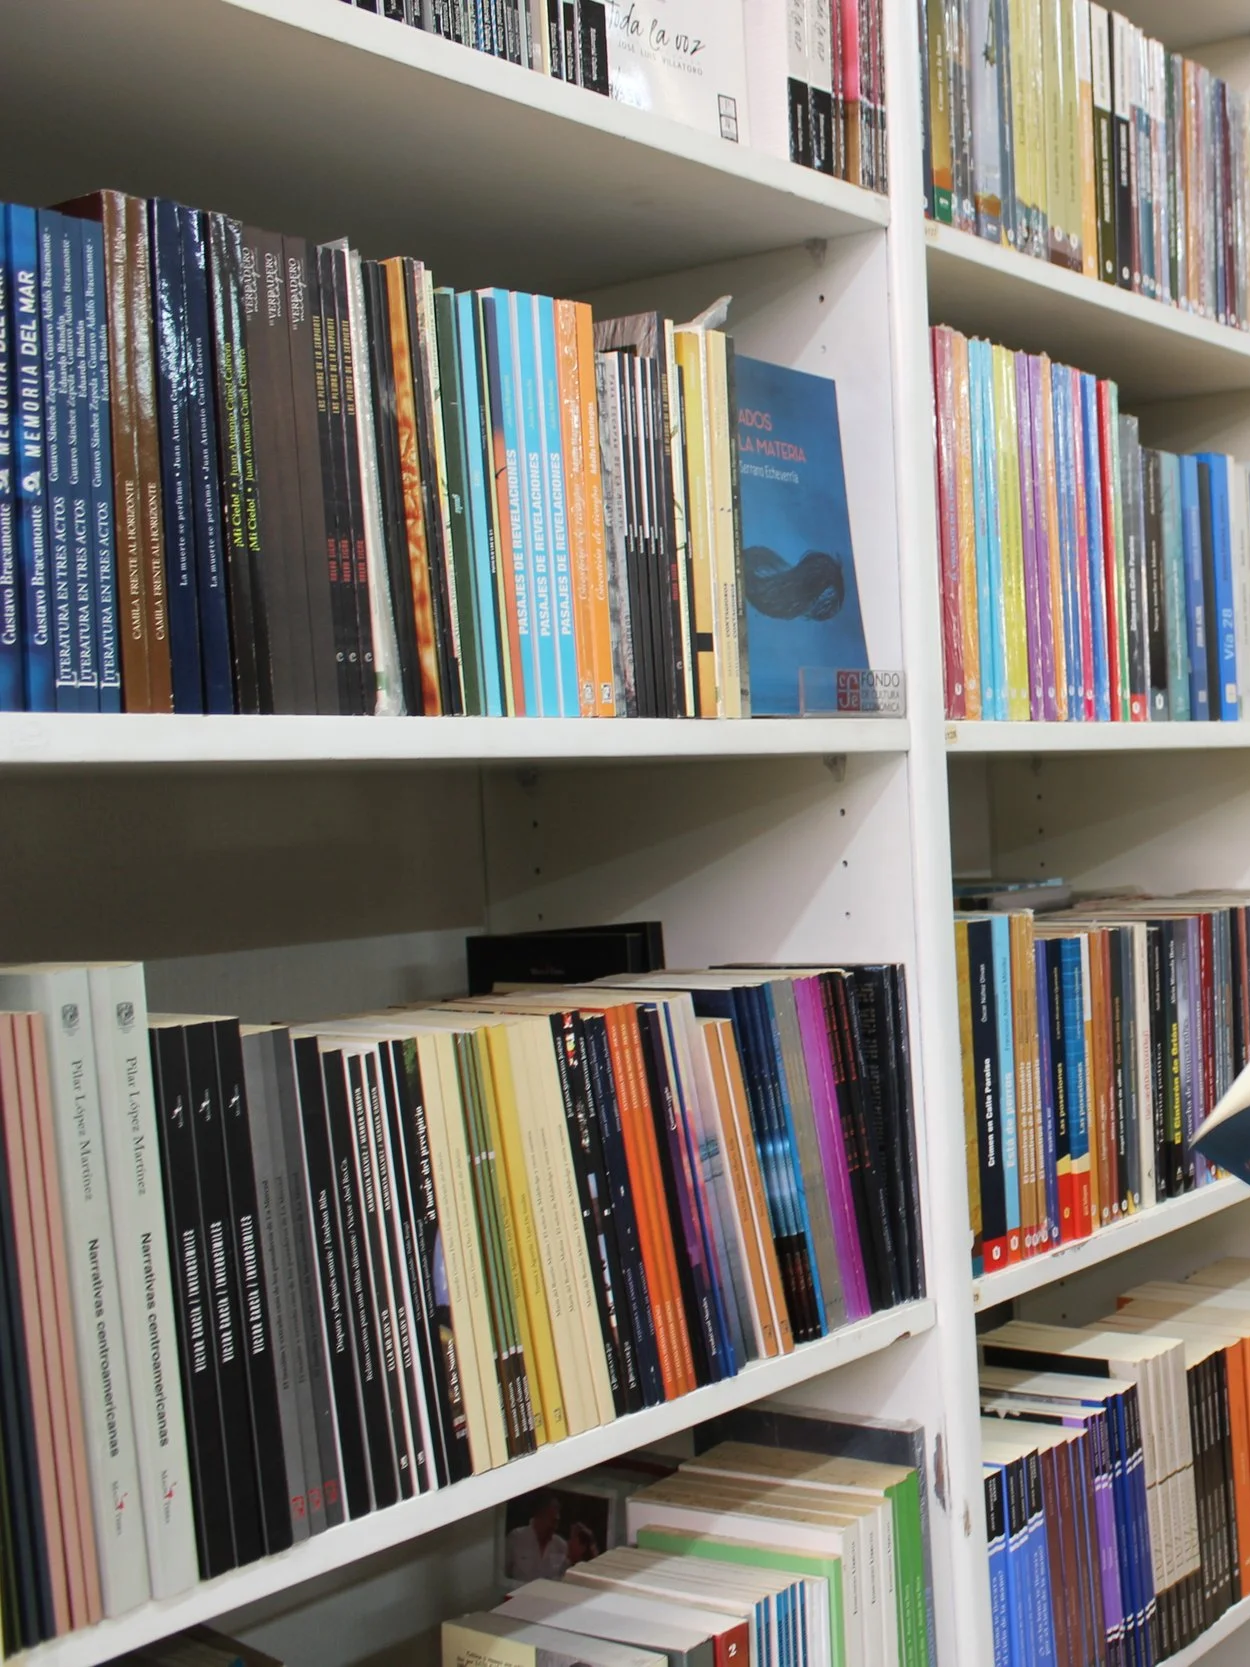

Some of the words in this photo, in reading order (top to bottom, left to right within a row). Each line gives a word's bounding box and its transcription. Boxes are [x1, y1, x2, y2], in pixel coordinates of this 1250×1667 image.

[650, 19, 670, 51] la
[18, 271, 36, 314] MAR
[242, 246, 256, 315] VERDADERO
[264, 252, 277, 320] VERDADERO
[288, 257, 301, 325] VERDADERO
[20, 320, 38, 356] DEL
[196, 337, 206, 378] Cabrera
[23, 365, 41, 458] MEMORIA
[197, 380, 206, 406] Canel
[172, 403, 181, 441] Antonio
[199, 409, 208, 444] Antonio
[227, 412, 238, 451] Antonio
[243, 418, 253, 457] Antonio
[173, 445, 182, 469] Juan
[201, 447, 210, 472] Juan
[246, 457, 256, 481] Juan
[756, 437, 807, 464] MATERIA
[126, 479, 137, 540] HORIZONTE
[149, 481, 159, 541] HORIZONTE
[176, 481, 187, 521] perfuma
[205, 484, 216, 523] perfuma
[232, 493, 241, 526] Cielo!
[247, 498, 256, 531] Cielo!
[507, 448, 523, 549] REVELACIONES
[530, 452, 546, 552] REVELACIONES
[551, 452, 566, 551] REVELACIONES
[55, 496, 66, 542] ACTOS
[76, 499, 86, 545] ACTOS
[98, 501, 109, 547] ACTOS
[177, 523, 185, 535] se
[206, 525, 214, 536] se
[0, 503, 15, 586] Bracamonte
[30, 505, 45, 587] Bracamonte
[129, 541, 138, 556] AL
[152, 541, 161, 556] AL
[178, 536, 187, 571] muerte
[208, 539, 217, 573] muerte
[233, 528, 245, 548] ¡Mi
[250, 532, 261, 552] ¡Mi
[57, 545, 69, 578] TRES
[78, 547, 89, 580] TRES
[100, 549, 111, 582] TRES
[128, 557, 139, 596] FRENTE
[153, 557, 164, 597] FRENTE
[514, 552, 525, 566] DE
[536, 555, 547, 573] DE
[558, 555, 569, 572] DE
[59, 582, 70, 601] EN
[80, 582, 90, 601] EN
[102, 584, 112, 603] EN
[179, 574, 188, 587] La
[209, 574, 218, 588] La
[2, 591, 18, 645] Gustavo
[34, 590, 48, 645] Gustavo
[131, 599, 142, 641] CAMILA
[155, 598, 166, 641] CAMILA
[516, 570, 529, 636] PASAJES
[537, 574, 550, 637] PASAJES
[559, 573, 572, 636] PASAJES
[1223, 608, 1234, 629] 28
[58, 604, 78, 689] LITERATURA
[77, 604, 97, 689] LITERATURA
[100, 607, 120, 690] LITERATURA
[1223, 633, 1235, 660] Vía
[861, 671, 900, 688] FONDO
[72, 1059, 86, 1090] Pilar
[126, 1056, 140, 1088] Pilar
[1171, 1058, 1180, 1073] de
[1057, 1062, 1067, 1116] posesiones
[1076, 1061, 1086, 1116] posesiones
[1172, 1075, 1182, 1129] Cinturón
[73, 1095, 88, 1137] López
[127, 1091, 142, 1133] López
[984, 1095, 994, 1120] Calle
[986, 1119, 994, 1133] en
[1078, 1116, 1086, 1134] Las
[1058, 1117, 1067, 1136] Las
[1173, 1130, 1182, 1143] El
[133, 1135, 148, 1197] Martínez
[421, 1158, 432, 1175] del
[986, 1134, 996, 1167] Crimen
[80, 1140, 95, 1202] Martínez
[424, 1177, 435, 1208] borde
[89, 1238, 107, 1318] Narrativas
[142, 1232, 159, 1310] Narrativas
[97, 1321, 121, 1458] centroamericanas
[148, 1314, 171, 1448] centroamericanas
[729, 1643, 738, 1659] 2
